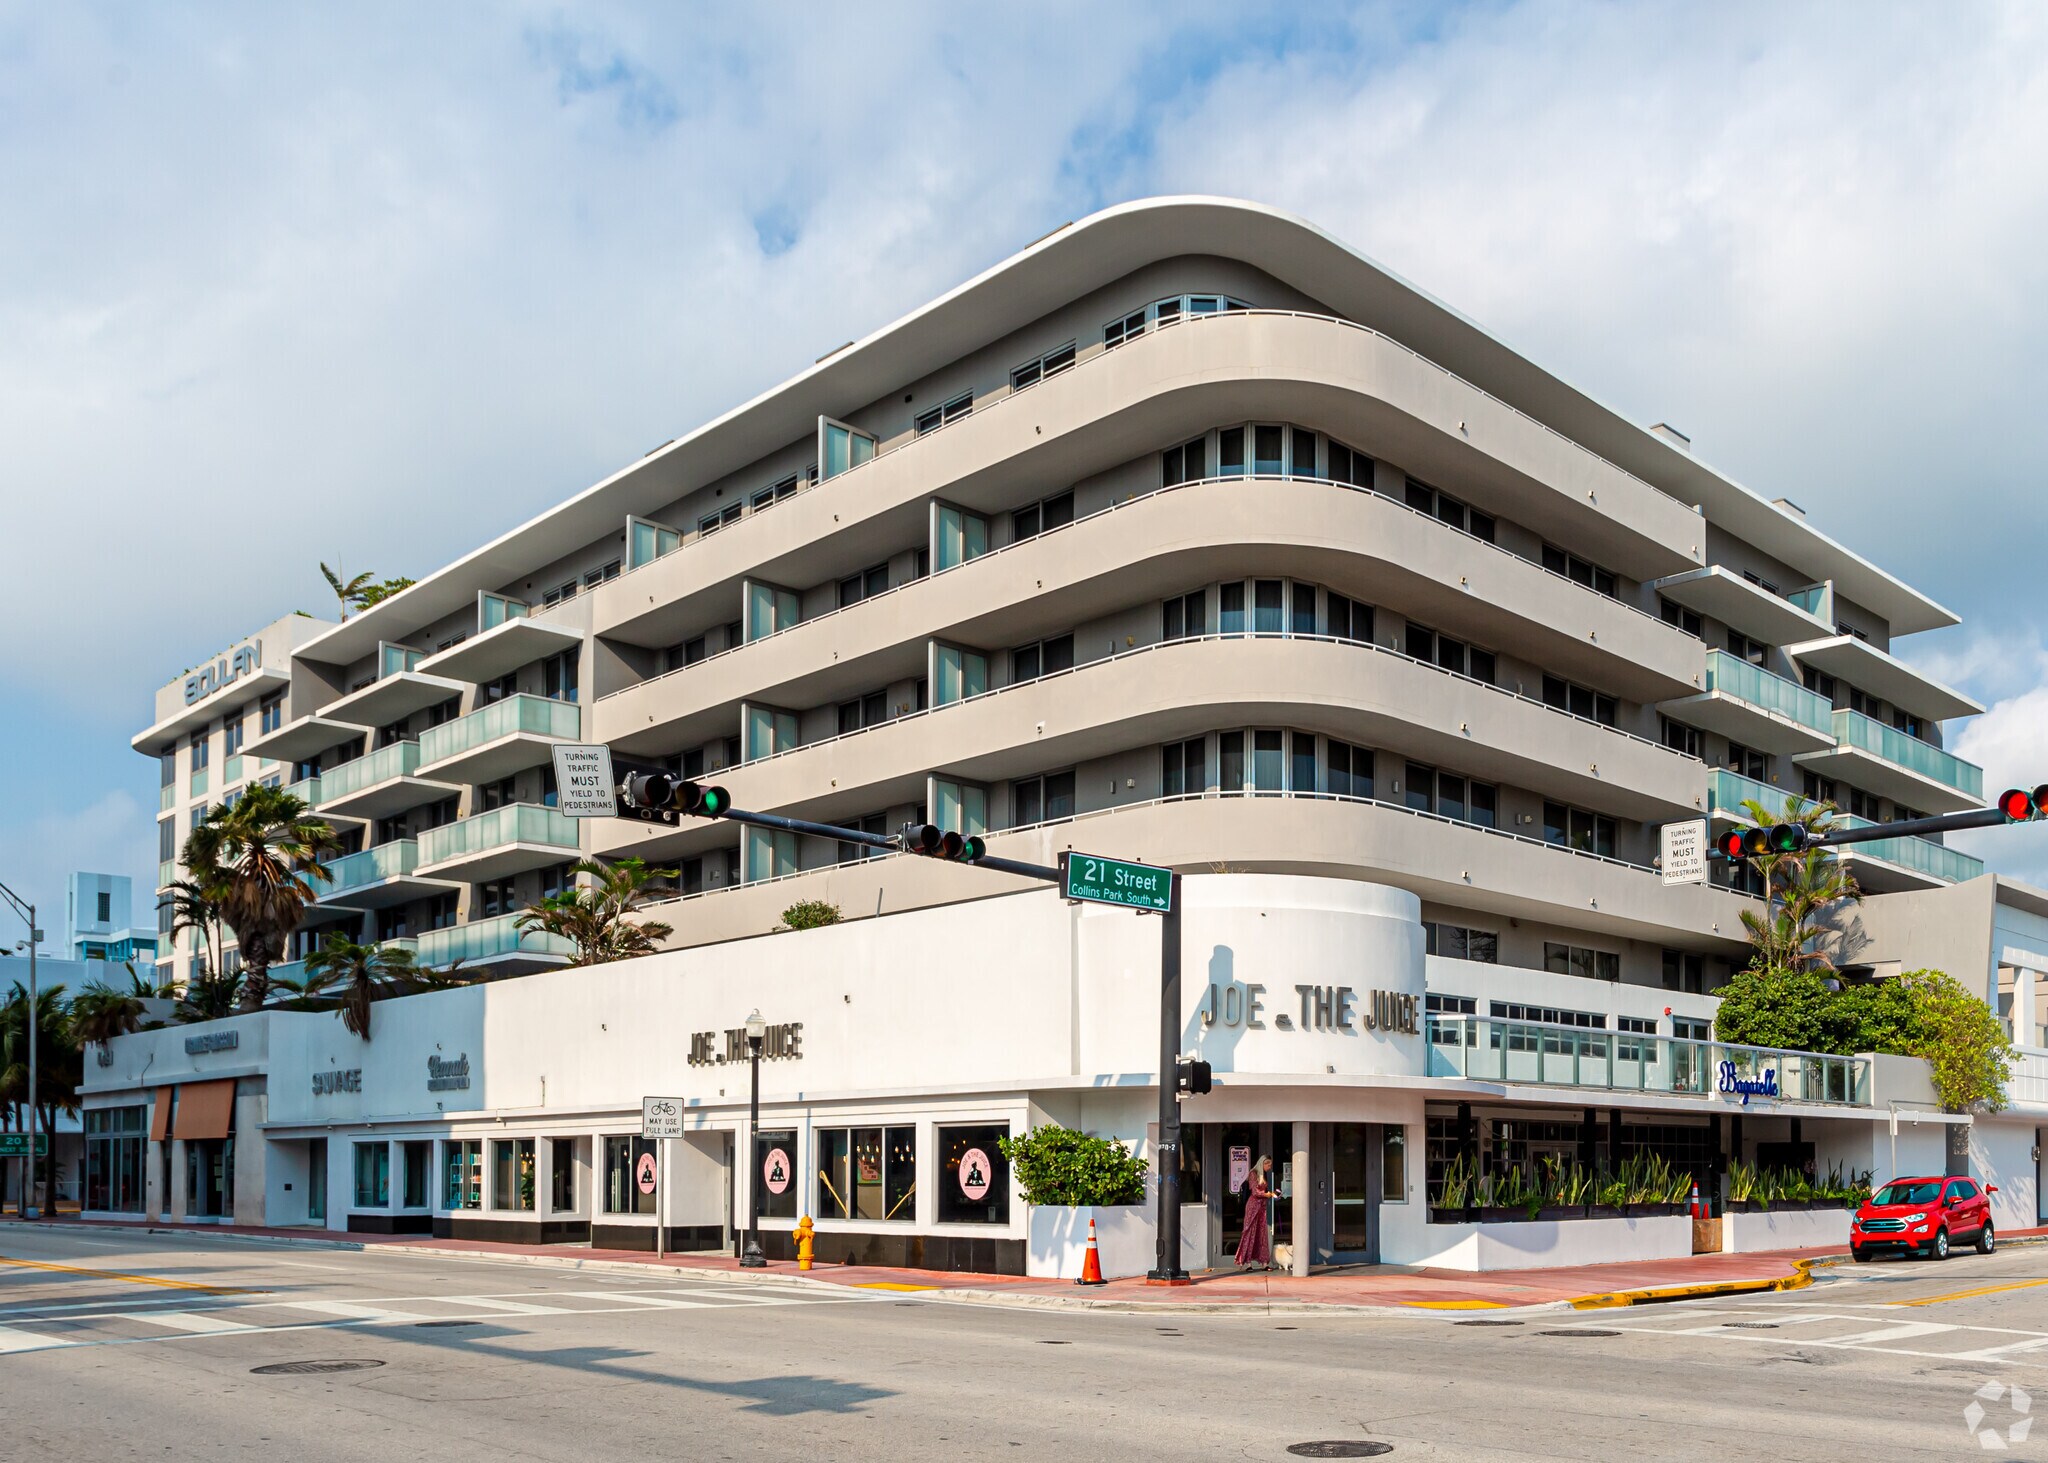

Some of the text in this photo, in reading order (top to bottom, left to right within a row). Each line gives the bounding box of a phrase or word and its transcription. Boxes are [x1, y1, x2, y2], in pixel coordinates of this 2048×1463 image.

[184, 639, 262, 706] BOULAN
[565, 753, 599, 761] TURNING
[571, 776, 599, 786] MUST
[1671, 828, 1696, 838] TURNING
[1671, 838, 1695, 847] TRAFFIC
[1673, 847, 1695, 858] MUST
[1671, 860, 1688, 868] YIELD
[1084, 859, 1157, 891] 21 Street
[1665, 867, 1703, 878] PEDESTRIANS
[1071, 883, 1151, 905] Collins Park South
[1201, 983, 1420, 1035] JOE & THE JUICE
[688, 1031, 715, 1066] JOE
[724, 1028, 751, 1063] THE
[758, 1023, 803, 1063] JUICE
[1719, 1060, 1778, 1105] Bagatelle
[6, 1137, 22, 1145] 20
